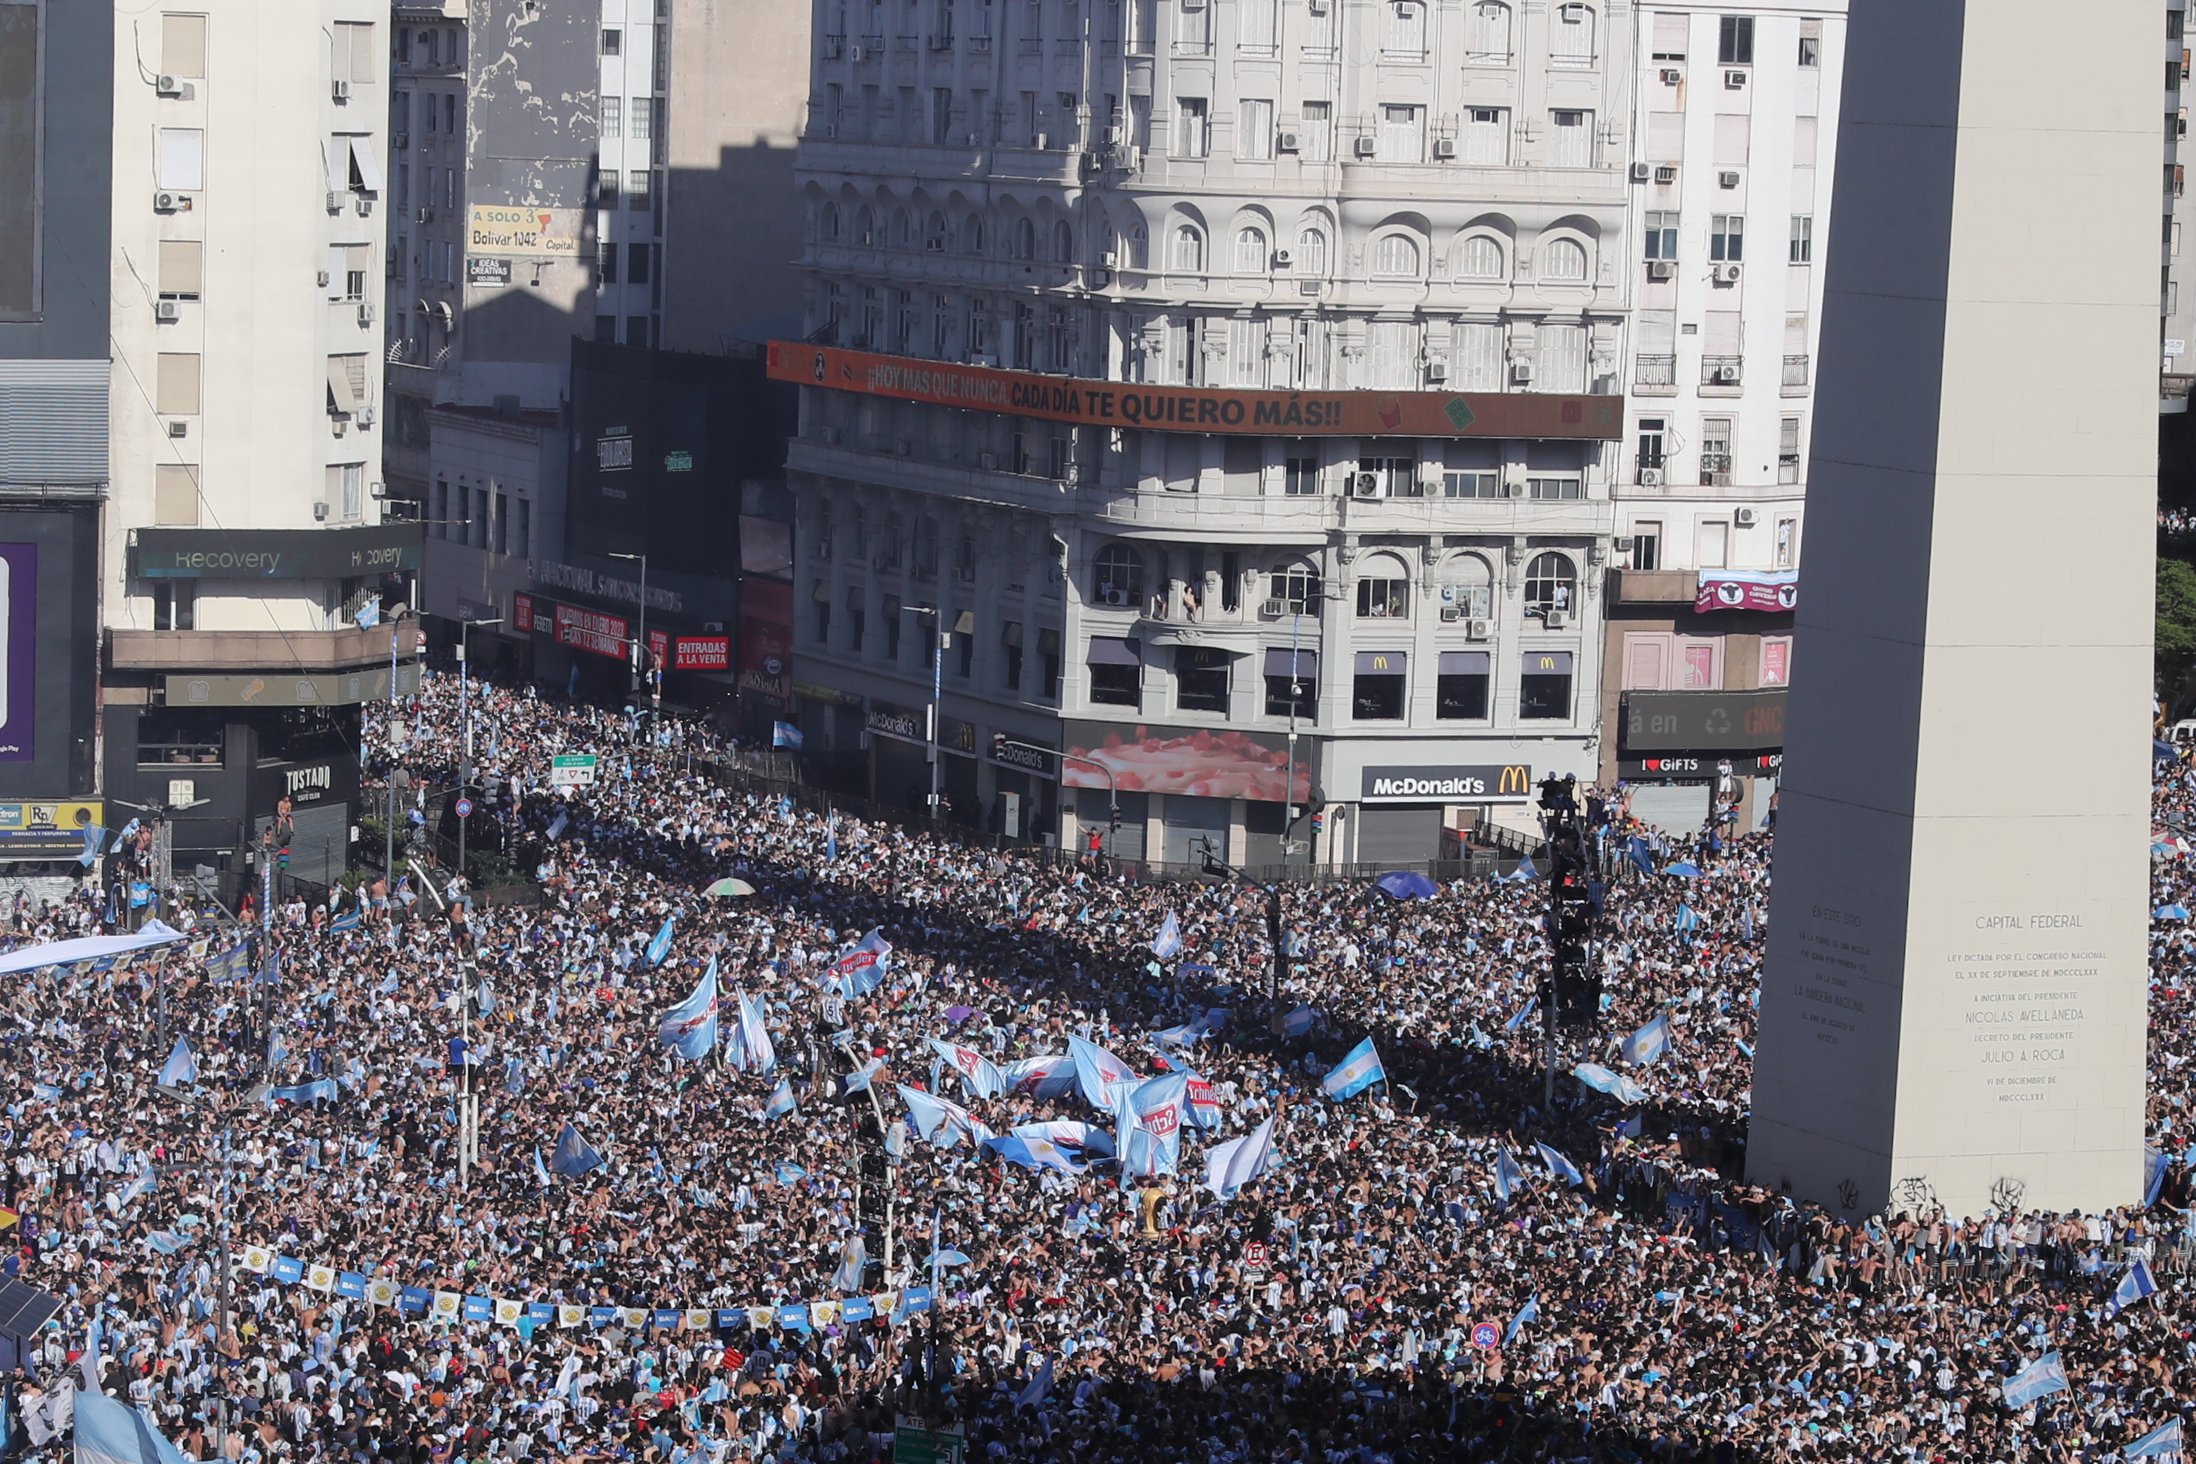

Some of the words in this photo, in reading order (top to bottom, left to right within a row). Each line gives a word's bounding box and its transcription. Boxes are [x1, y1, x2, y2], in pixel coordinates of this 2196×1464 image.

[474, 212, 482, 222] A
[487, 212, 520, 222] SOLO
[470, 266, 508, 276] CREATIVAS
[932, 372, 958, 398] QUE
[1012, 383, 1050, 411] CADA
[1052, 381, 1080, 414] DÍA
[1085, 390, 1114, 417] TE
[1120, 394, 1245, 425] QUIERO
[1254, 394, 1342, 426] MÁS!!
[678, 642, 726, 654] ENTRADAS
[677, 654, 684, 664] A
[686, 654, 697, 664] LA
[699, 654, 726, 664] VENTA
[869, 711, 914, 736] McDonald's
[1651, 714, 1677, 734] en
[8, 745, 20, 753] Play
[1002, 746, 1044, 769] cDonald's
[286, 766, 330, 794] TOSTADO
[1373, 777, 1485, 795] McDonald's
[1976, 915, 2024, 930] CAPITAL
[2030, 914, 2083, 929] FEDERAL
[1964, 954, 1994, 962] DICTADA
[1996, 954, 2012, 962] POR
[2014, 953, 2024, 961] EL
[2026, 952, 2069, 961] CONGRESO
[2071, 952, 2107, 960] NACIONAL
[1955, 972, 1964, 980] EL
[1968, 971, 1977, 979] XX
[1980, 970, 1990, 978] DE
[1993, 970, 2038, 978] SEPTIEMBRE
[2041, 969, 2050, 977] DE
[1980, 994, 2016, 1002] INICIATIVA
[2018, 993, 2032, 1001] DEL
[2034, 992, 2078, 1000] PRESIDENTE
[1966, 1010, 2014, 1024] NICOLAS
[2020, 1008, 2084, 1022] AVELLANEDA
[1974, 1034, 2010, 1042] DECRETO
[2012, 1033, 2026, 1042] DEL
[2030, 1032, 2074, 1040] PRESIDENTE
[1981, 1050, 2014, 1064] JULIO
[2032, 1048, 2065, 1062] ROCA
[1996, 1078, 2005, 1086] DE
[2008, 1076, 2046, 1086] DICIEMBRE
[2048, 1076, 2057, 1084] DE
[754, 1356, 766, 1368] 10
